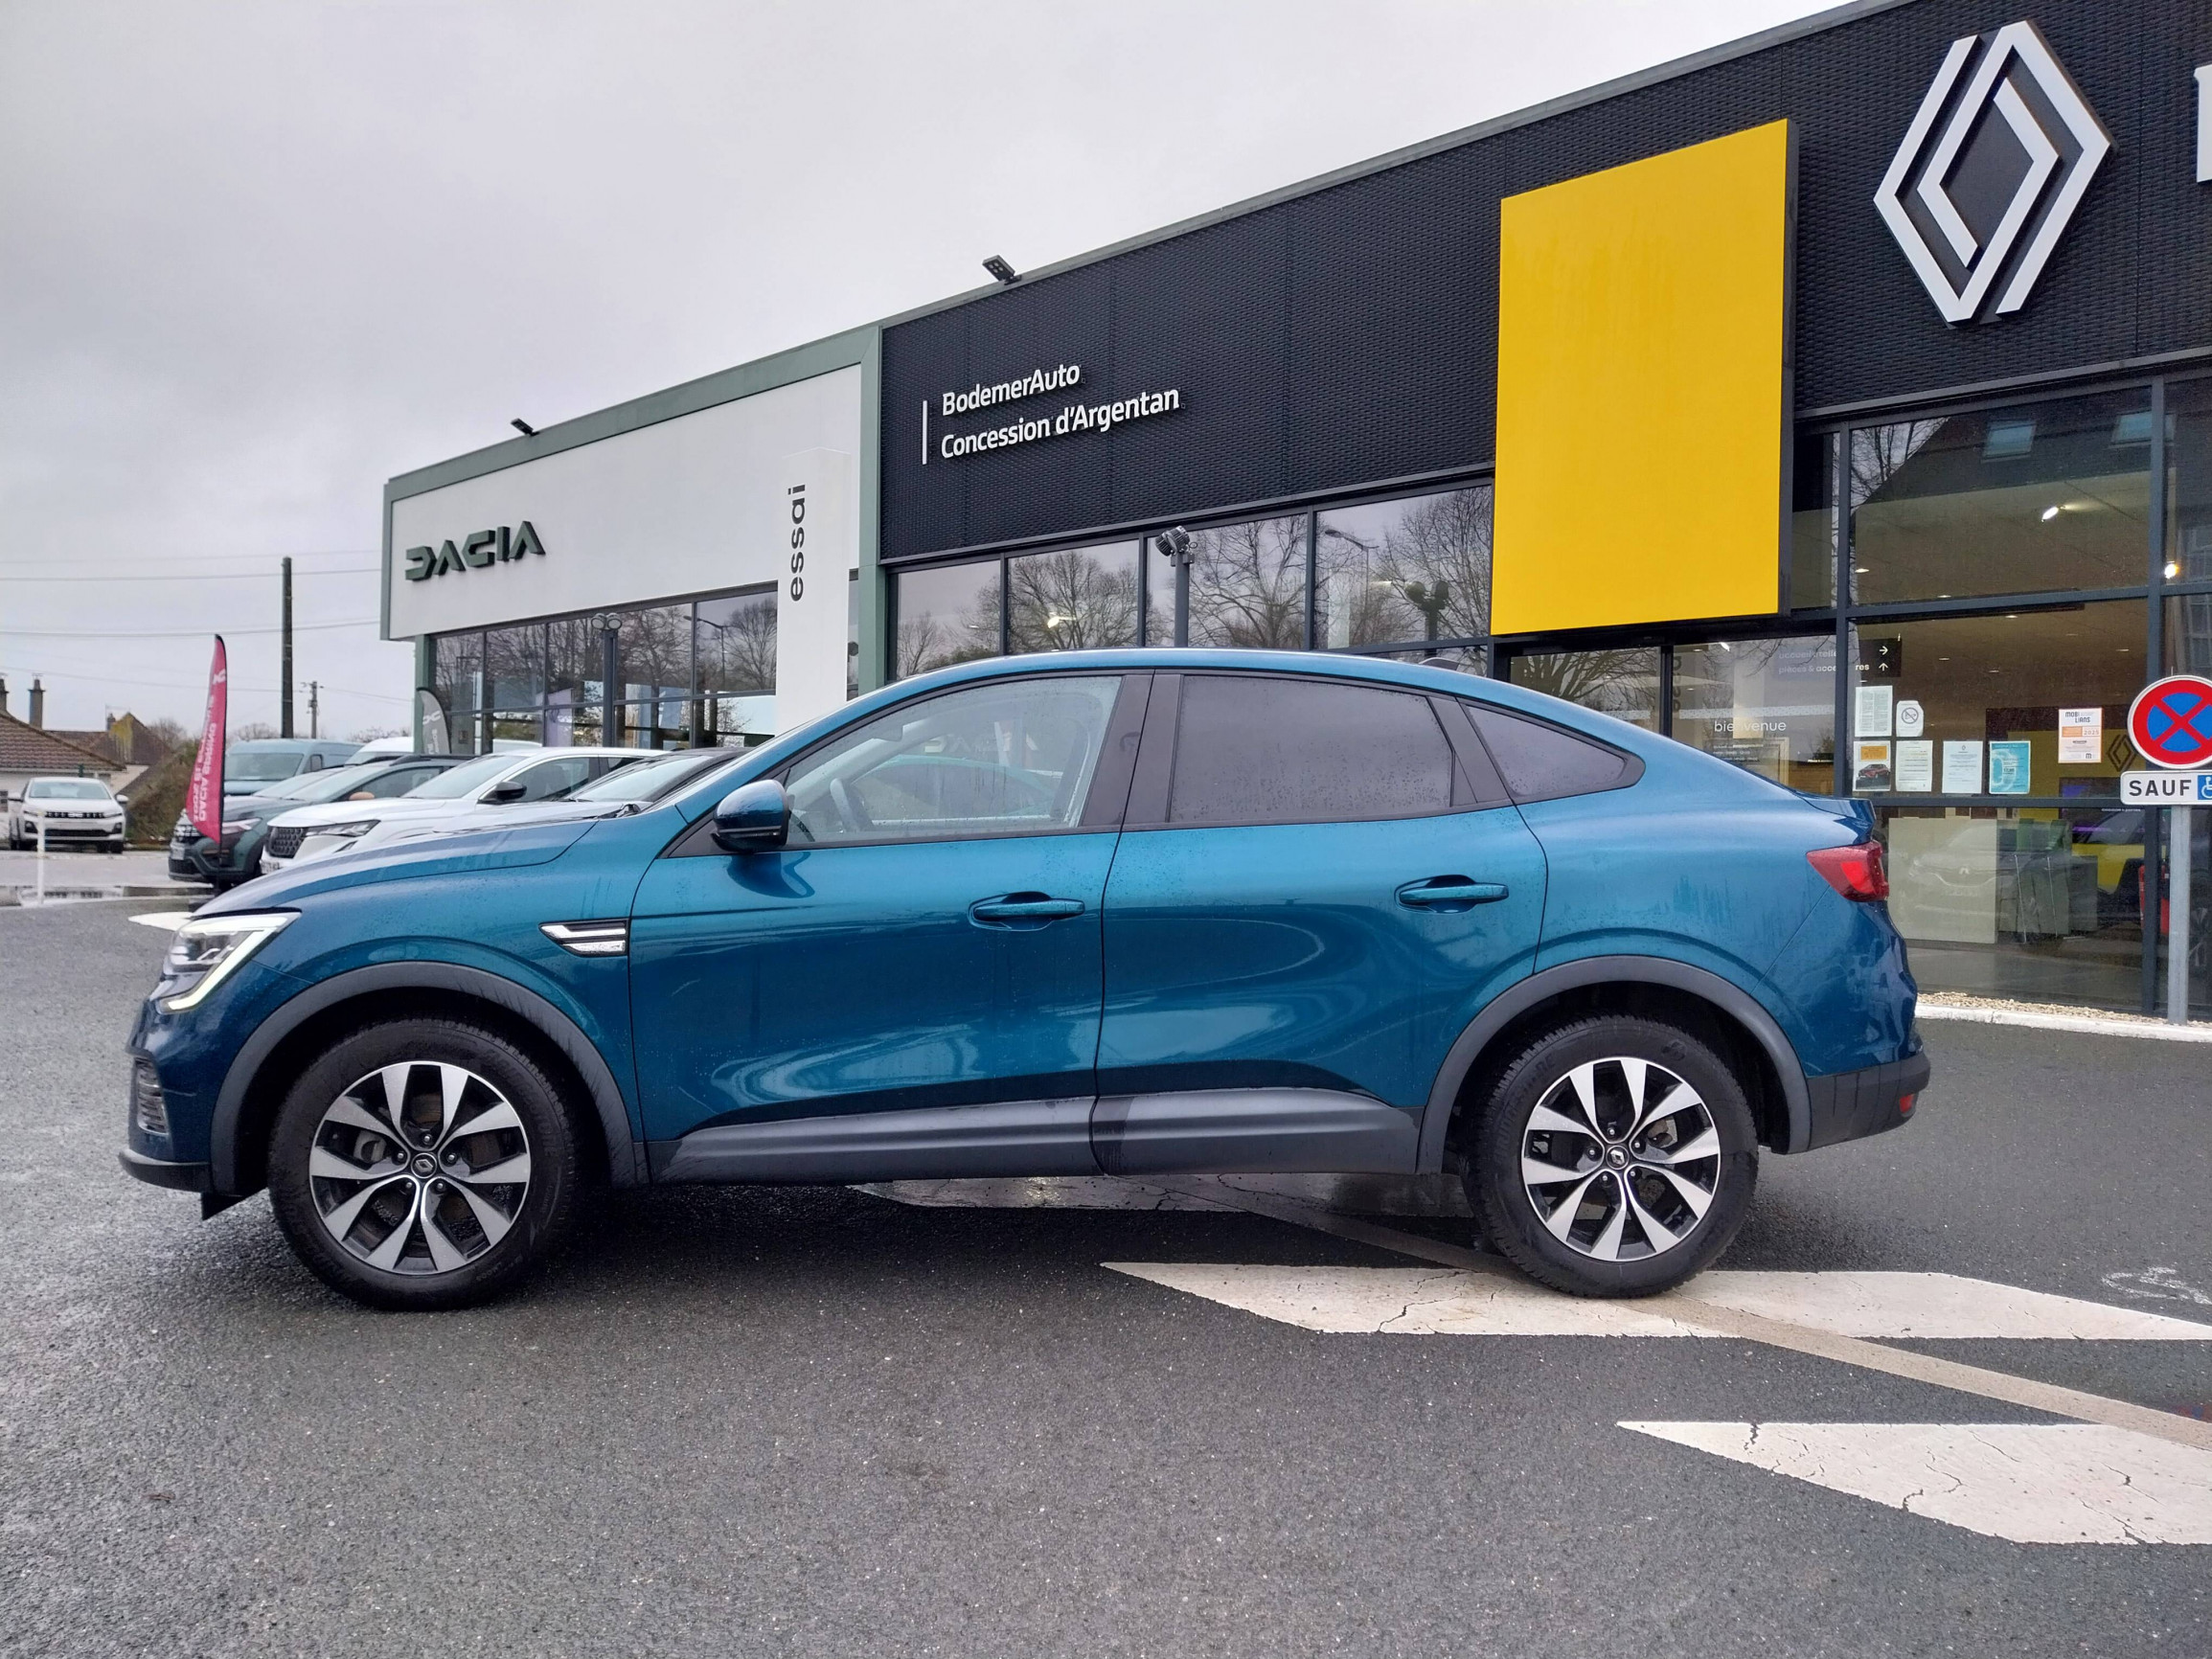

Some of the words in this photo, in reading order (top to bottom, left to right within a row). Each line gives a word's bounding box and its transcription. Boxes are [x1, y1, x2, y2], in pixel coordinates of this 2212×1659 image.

[942, 363, 1081, 416] BodemerAuto
[941, 417, 1051, 459] Concession
[1056, 387, 1180, 433] d'Argentan
[405, 520, 546, 581] DACIA
[787, 484, 806, 602] essai
[1714, 720, 1787, 733] bievenue
[2129, 779, 2192, 797] SAUF
